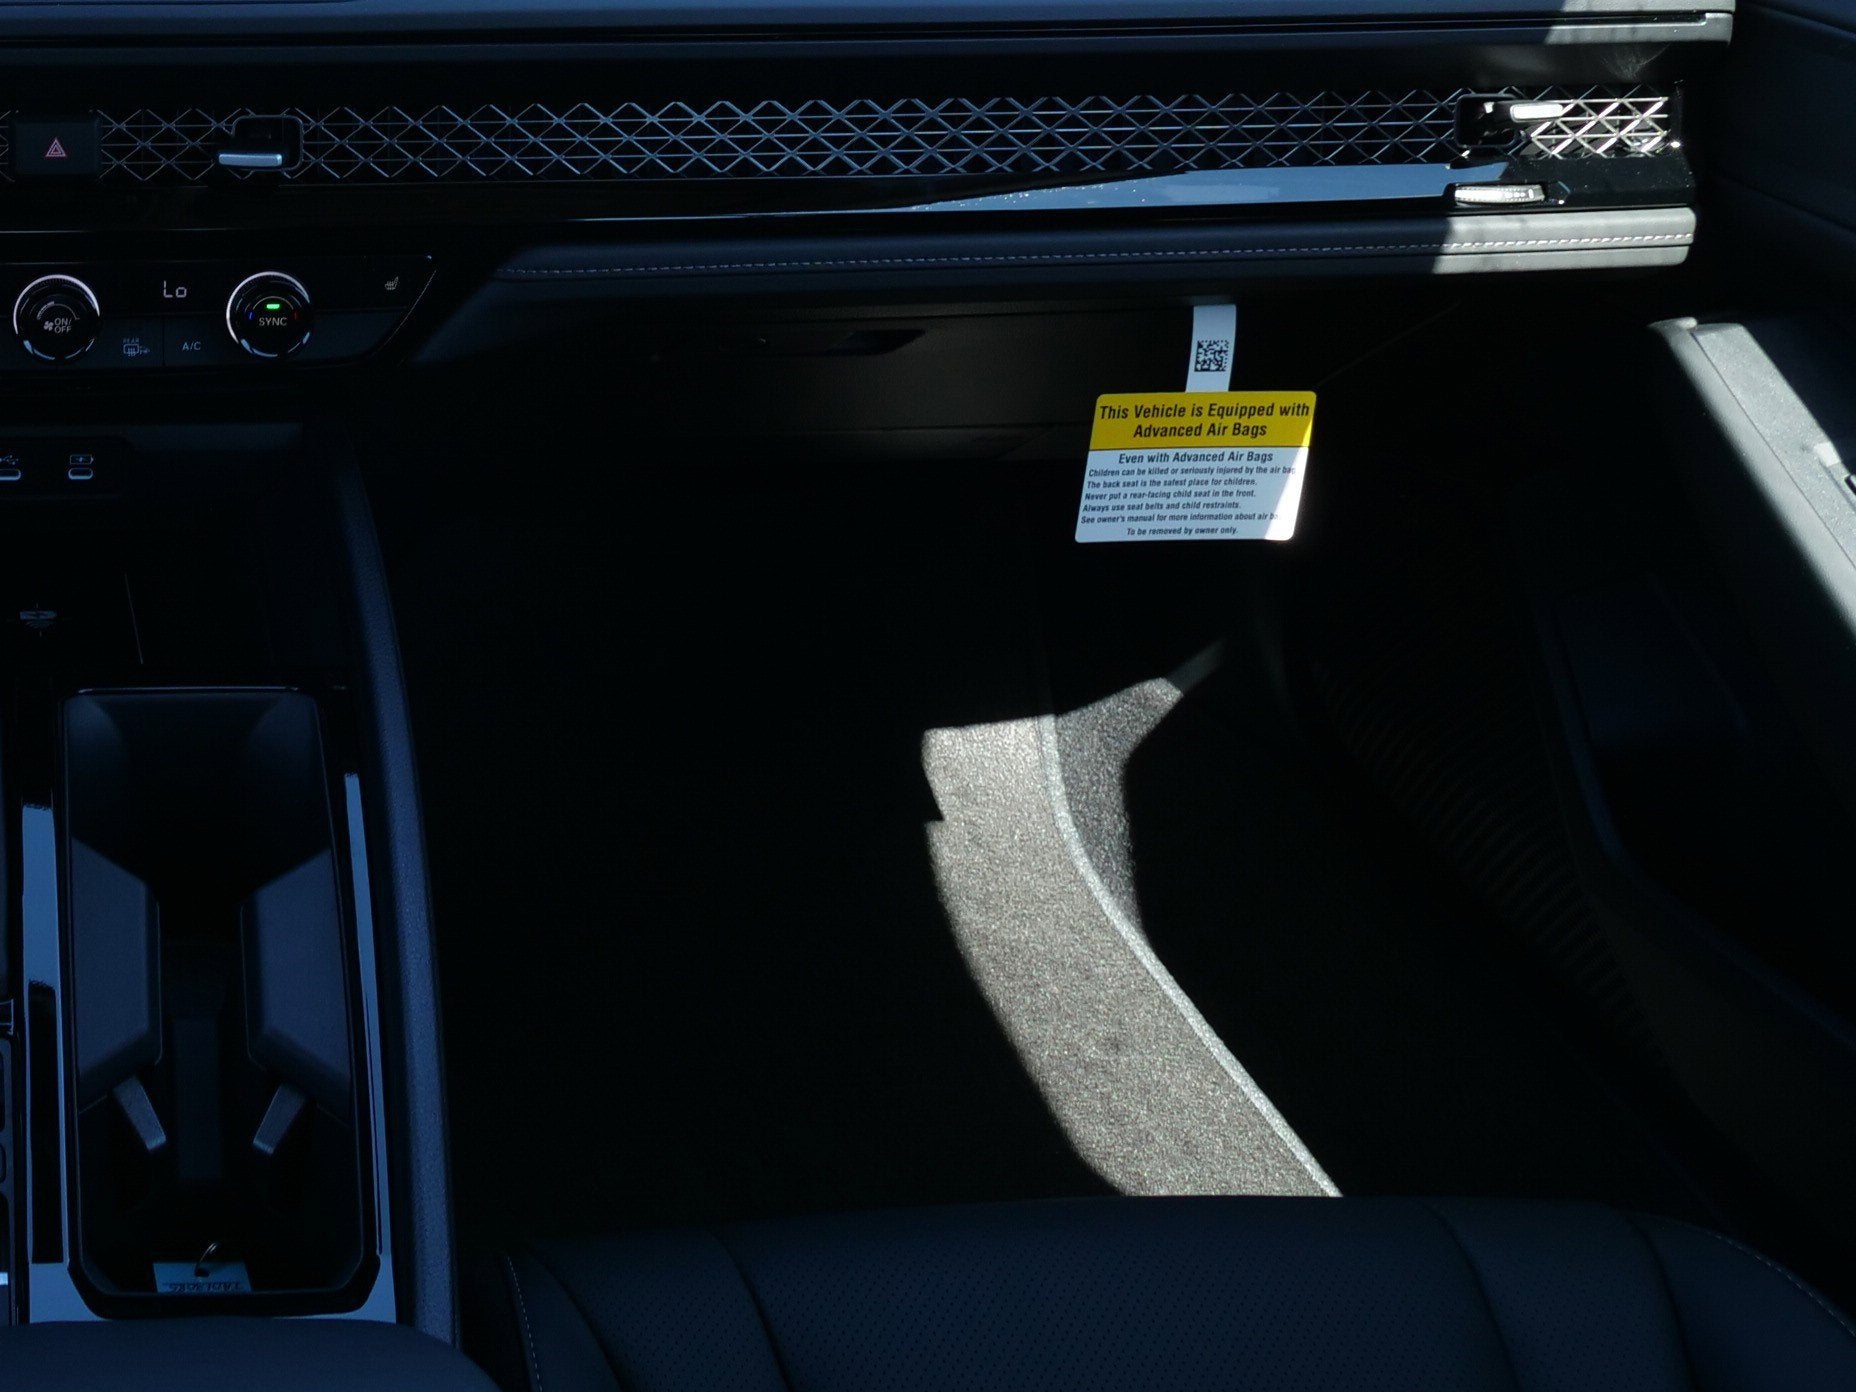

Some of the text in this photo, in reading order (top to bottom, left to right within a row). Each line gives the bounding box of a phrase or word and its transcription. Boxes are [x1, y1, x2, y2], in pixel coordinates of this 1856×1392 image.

[54, 317, 72, 326] ON/
[258, 316, 287, 327] SYNC
[54, 325, 72, 334] OFF
[182, 341, 202, 351] A/C
[1100, 402, 1310, 420] This Vehicle is Equipped with
[1133, 422, 1268, 439] Advanced Air Bags
[1118, 451, 1274, 464] Even with Advanced Air Bags
[1088, 468, 1120, 477] Children
[1137, 467, 1146, 475] be
[1148, 467, 1169, 475] killed
[1180, 466, 1214, 475] seriously
[1216, 466, 1243, 475] injured
[1245, 466, 1254, 475] by
[1256, 465, 1268, 474] the
[1269, 466, 1281, 474] air
[1087, 477, 1258, 489] The back seat is the safest place for children.
[1109, 492, 1122, 501] put
[1130, 490, 1171, 500] rear-facing
[1173, 490, 1192, 498] child
[1193, 490, 1210, 498] seat
[1212, 489, 1220, 497] in
[1221, 489, 1234, 497] the
[1236, 489, 1256, 497] front.
[1082, 504, 1110, 513] Always
[1127, 503, 1144, 511] seat
[1145, 502, 1164, 510] belts
[1182, 501, 1201, 509] child
[1203, 501, 1241, 509] restraints.
[1081, 515, 1095, 524] See
[1097, 515, 1125, 523] owner's
[1127, 514, 1155, 522] manual
[1190, 513, 1233, 521] information
[1137, 527, 1146, 535] be
[1148, 527, 1182, 535] removed
[1184, 527, 1193, 535] by
[1220, 527, 1238, 535] only.
